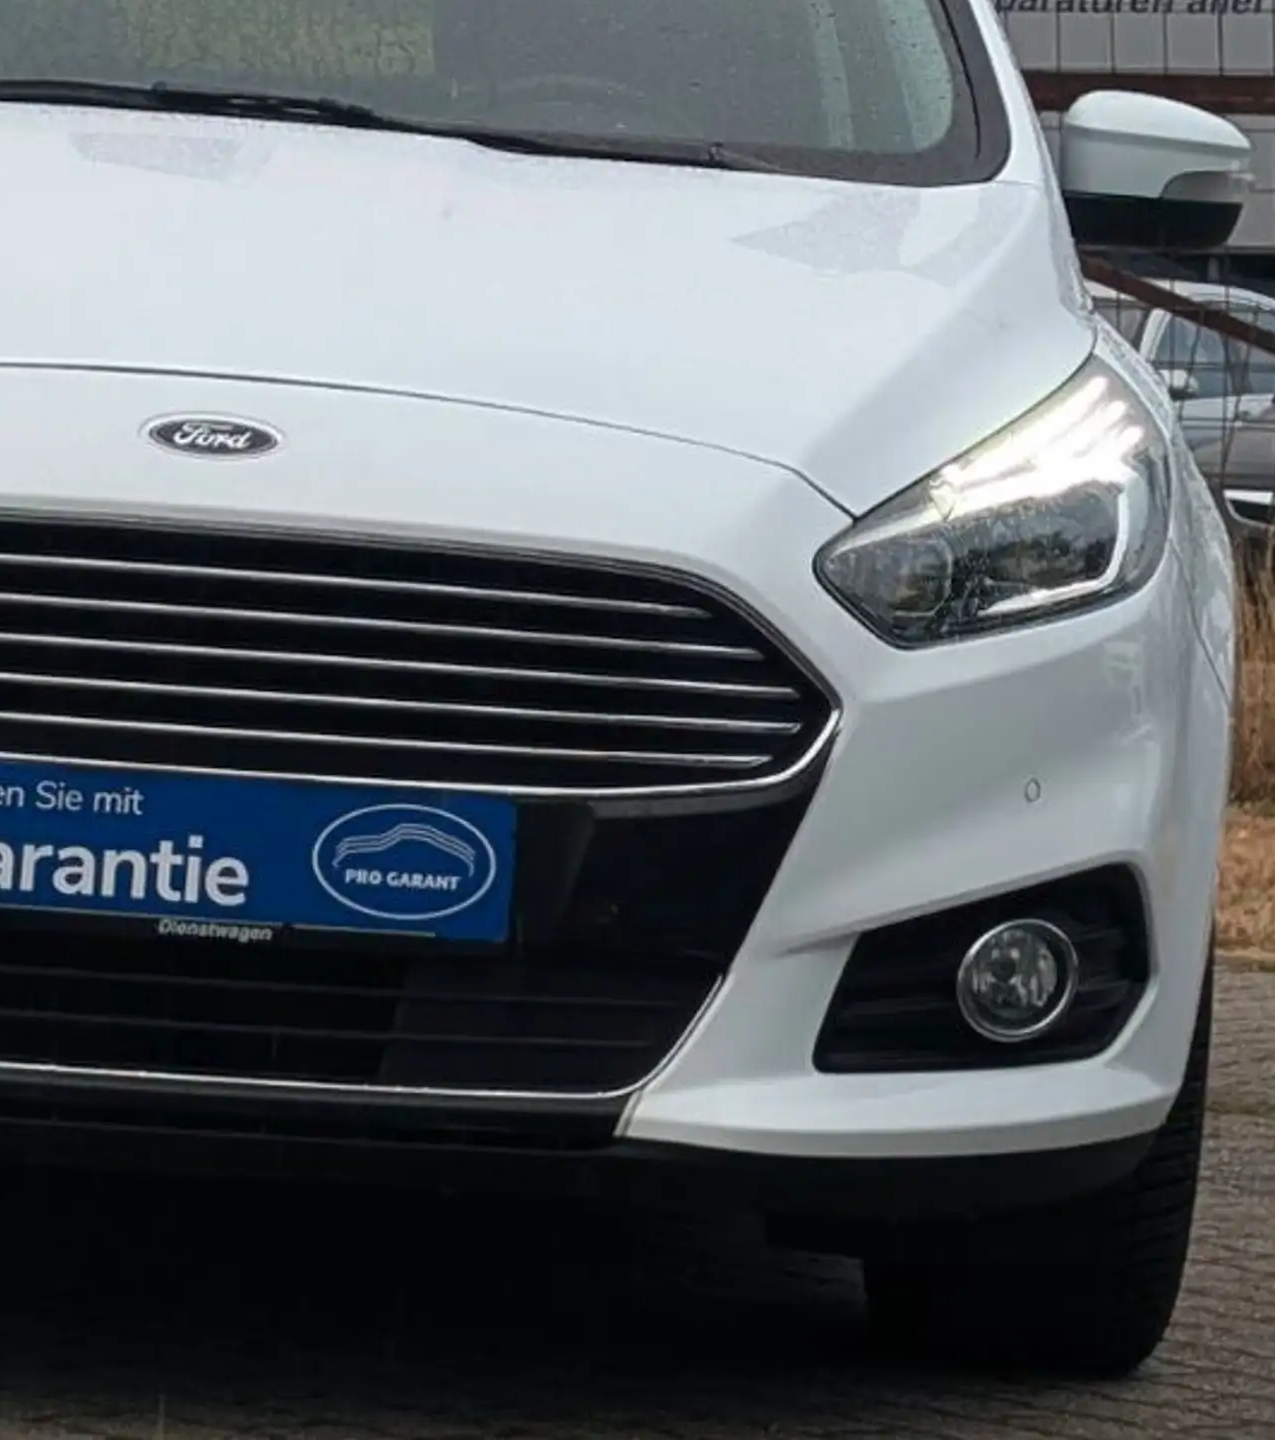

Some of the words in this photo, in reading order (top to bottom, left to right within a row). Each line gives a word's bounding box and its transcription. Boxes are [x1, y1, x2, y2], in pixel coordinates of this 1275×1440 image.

[172, 421, 252, 450] Ford
[34, 779, 84, 813] Sie
[92, 783, 144, 816] mit
[344, 868, 383, 886] PRO
[386, 871, 462, 892] GARANT
[157, 917, 274, 942] Dienstwagen
